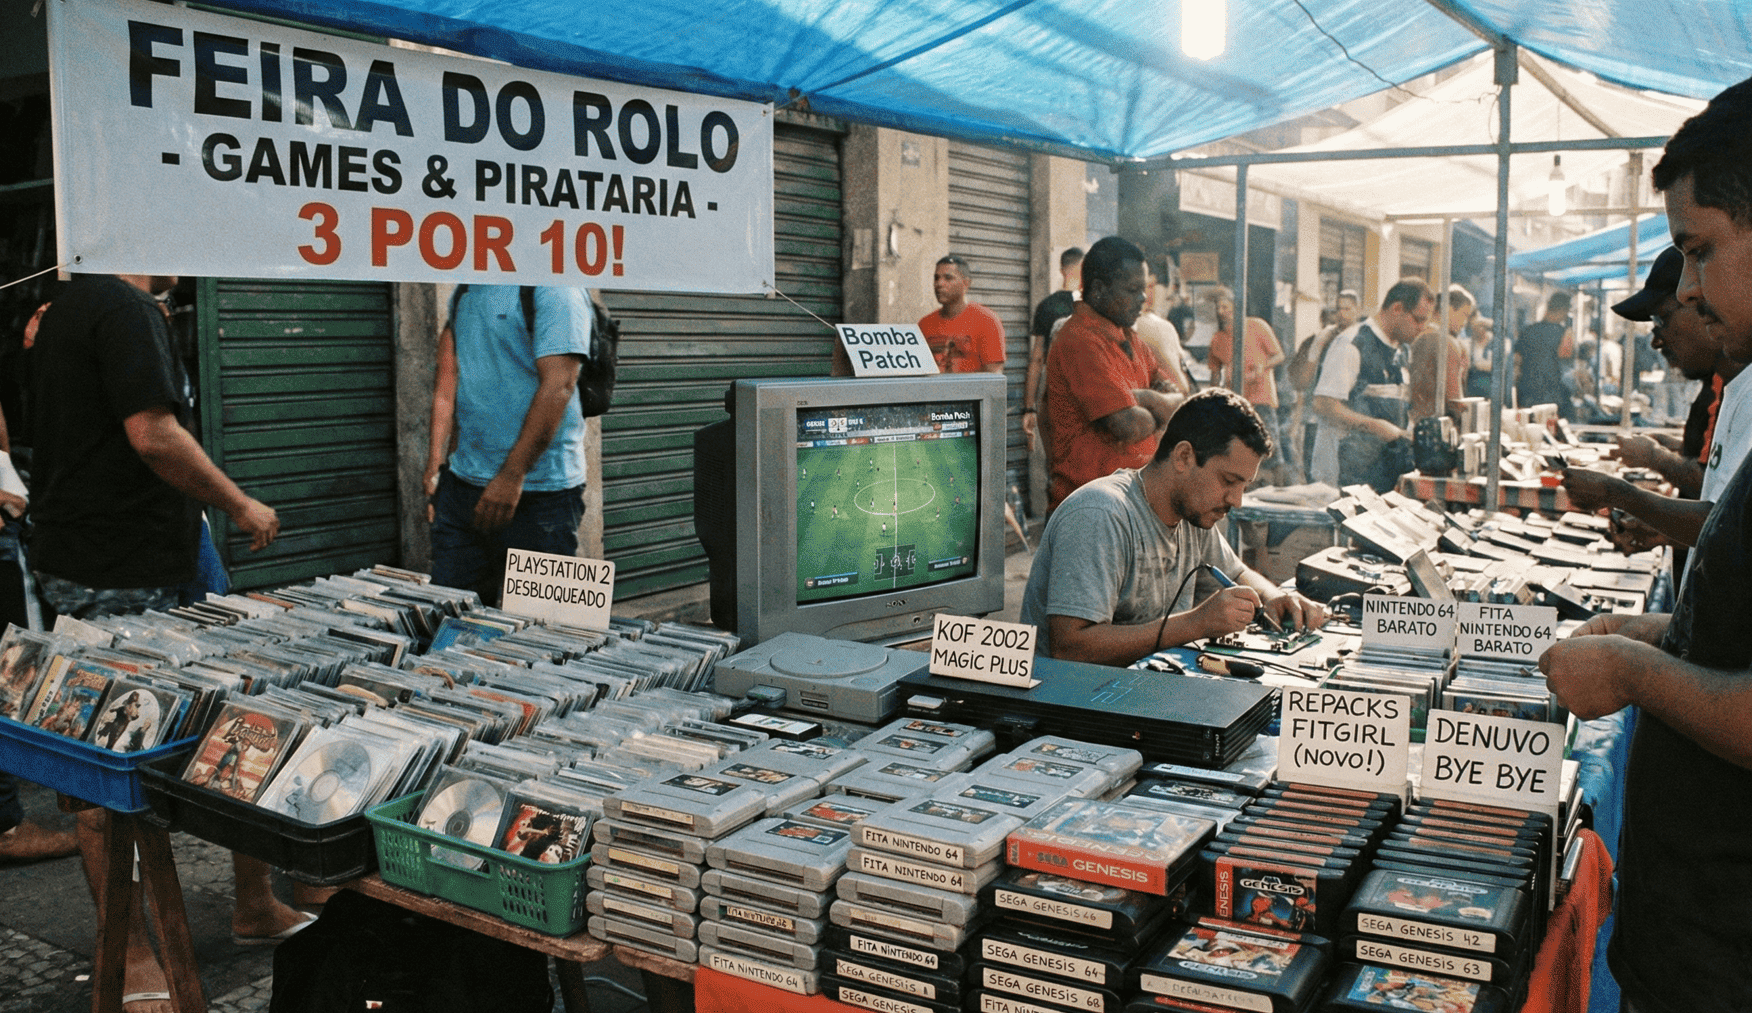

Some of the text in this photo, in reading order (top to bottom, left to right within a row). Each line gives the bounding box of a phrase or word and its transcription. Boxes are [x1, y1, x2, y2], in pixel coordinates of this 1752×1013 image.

[128, 20, 739, 173] FEIRA DO ROLO
[162, 132, 718, 219] - GAMES & PIRATARIA -
[297, 202, 625, 277] 3 POR 10!
[842, 327, 919, 345] Bomba
[858, 350, 921, 369] Patch
[508, 553, 611, 585] PLAYSTATION 2
[506, 578, 606, 608] DESBLOQUEADO
[1365, 600, 1455, 618] NINTENDO 64
[1479, 606, 1514, 620] FITA
[937, 620, 1029, 650] KOF 2002
[1377, 619, 1437, 636] BARATO
[1534, 625, 1551, 640] 64
[1474, 639, 1532, 655] BARATO
[990, 655, 1028, 677] PLUS
[1289, 691, 1399, 719] REPACKS
[1293, 718, 1395, 746] FITGIRL
[1434, 717, 1549, 755] DENUVO
[1294, 743, 1385, 776] (NOVO!)
[1434, 755, 1547, 793] BYE BYE
[865, 830, 888, 844] FITA
[945, 848, 958, 860] 64
[863, 857, 962, 887] FITA NINTENDO 64
[1072, 859, 1148, 883] GENESIS
[999, 893, 1028, 907] SEGA
[1220, 871, 1229, 917] ENESIS
[857, 939, 877, 952] FITA
[1361, 918, 1393, 932] SEGA
[1463, 933, 1481, 946] 42
[713, 956, 735, 971] FITA
[786, 976, 798, 987] 64
[987, 944, 1018, 960] SEGA
[1084, 965, 1098, 978] 64
[1360, 945, 1392, 960] SEGA
[1463, 962, 1480, 975] 63
[989, 974, 1021, 990] SEGA
[842, 989, 868, 1005] SEGA
[984, 998, 1010, 1013] FITA
